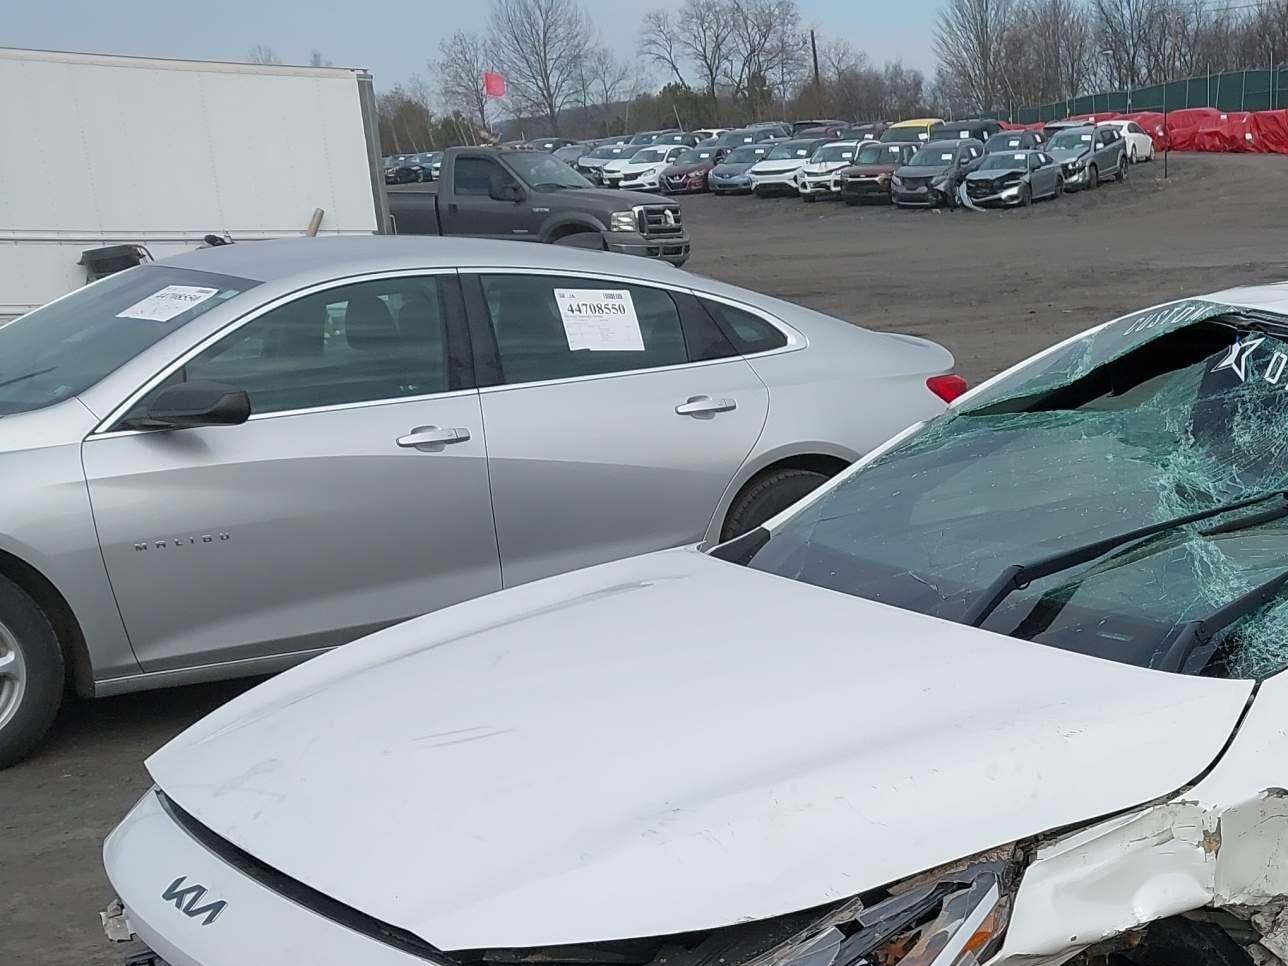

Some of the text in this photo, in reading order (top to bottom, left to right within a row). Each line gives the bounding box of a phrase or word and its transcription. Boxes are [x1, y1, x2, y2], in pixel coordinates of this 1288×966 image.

[567, 303, 626, 315] 44708550
[133, 530, 231, 552] MALIBU
[161, 875, 228, 926] KIA
